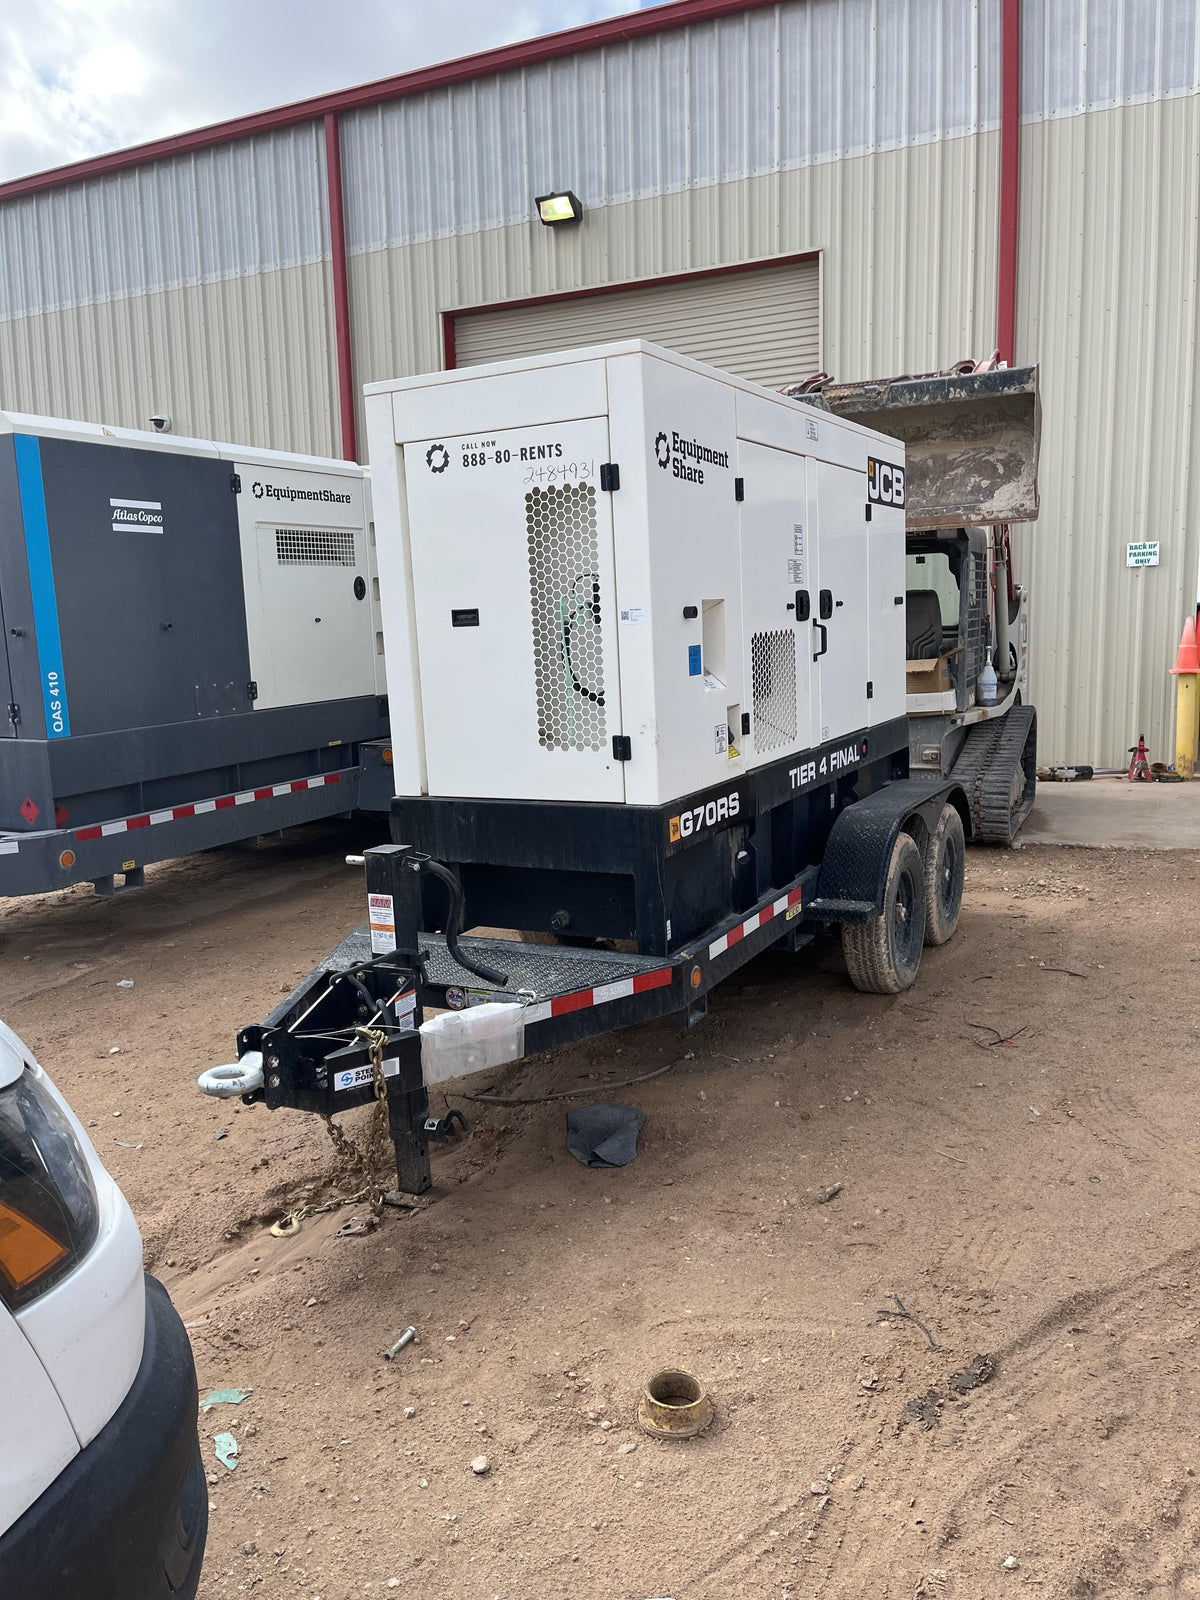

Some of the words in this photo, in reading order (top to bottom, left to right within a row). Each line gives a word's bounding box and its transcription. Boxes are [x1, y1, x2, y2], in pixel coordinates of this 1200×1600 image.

[461, 443, 478, 451] CALL
[481, 440, 497, 448] NOW
[462, 443, 563, 468] 888-80-RENTS
[672, 431, 729, 469] Equipment
[672, 457, 704, 485] Share
[868, 462, 905, 505] JCB
[265, 484, 351, 504] EquipmentShare
[112, 509, 138, 521] Atlas
[138, 511, 163, 524] Copco
[47, 671, 60, 697] 410
[50, 700, 64, 733] QAS
[788, 761, 816, 789] TIER
[819, 756, 828, 776] 4
[830, 744, 860, 772] FINAL
[680, 792, 740, 837] G70RS
[370, 899, 391, 909] RAM
